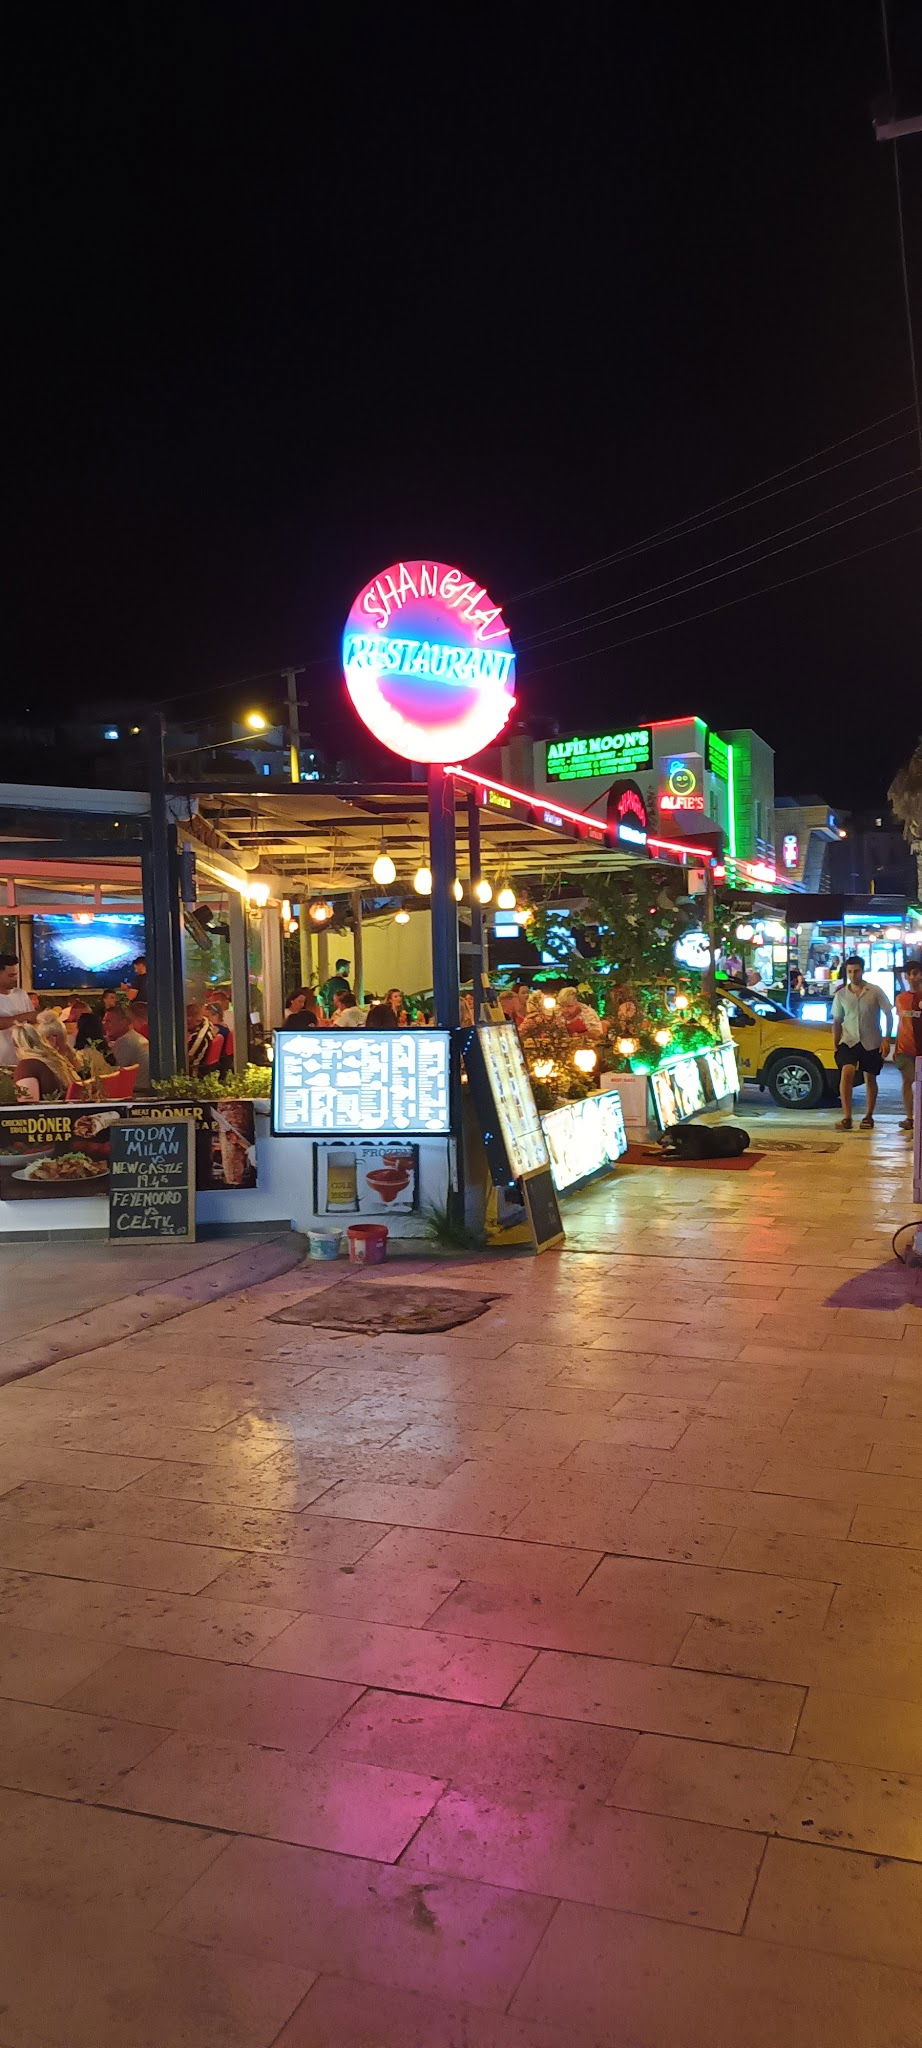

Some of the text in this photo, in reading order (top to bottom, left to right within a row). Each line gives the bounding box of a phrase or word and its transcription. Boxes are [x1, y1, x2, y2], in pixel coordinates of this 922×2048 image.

[348, 635, 516, 684] RESTAURANT
[660, 796, 704, 810] ALFIE'S
[27, 1113, 72, 1134] DÖNER
[28, 1133, 72, 1142] KEBAP
[120, 1126, 176, 1142] TODAY
